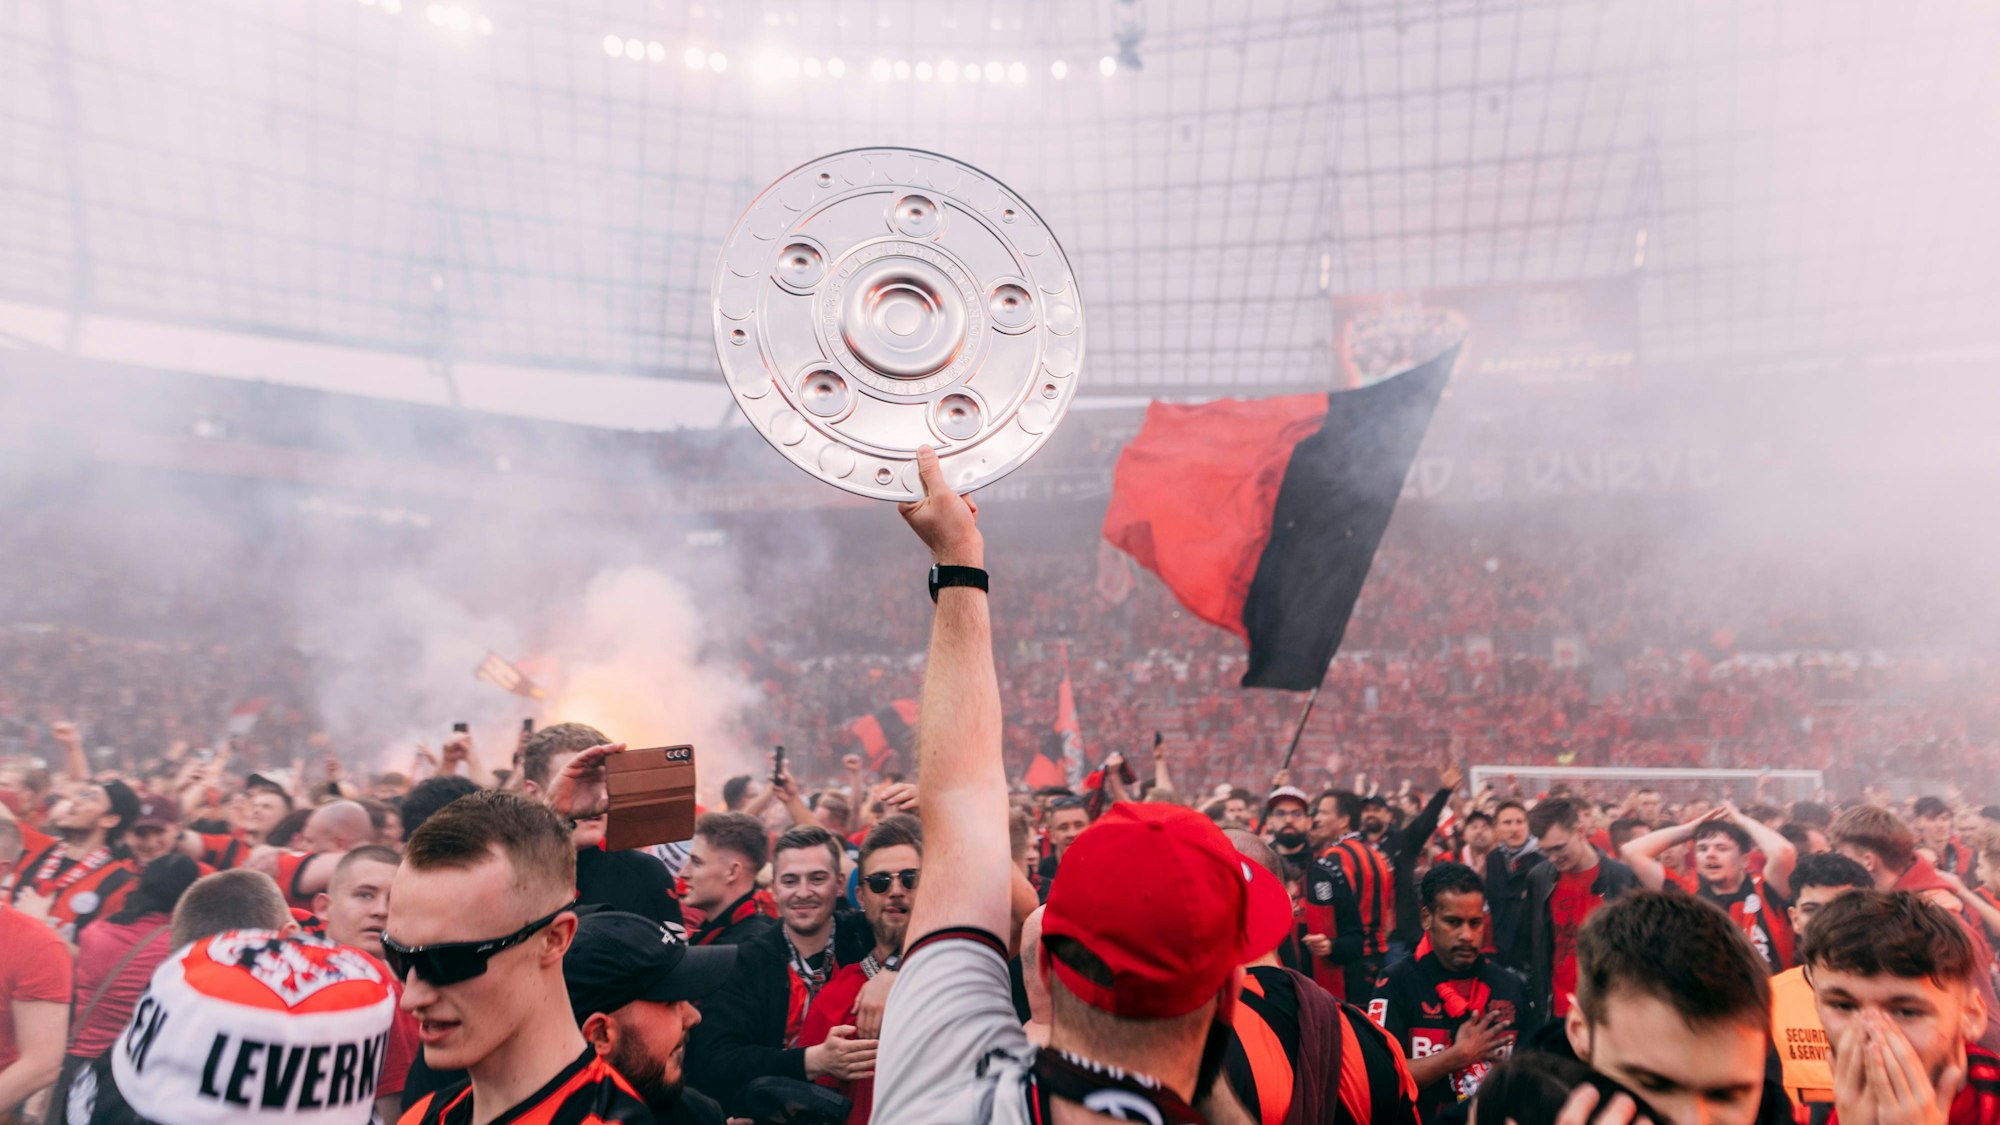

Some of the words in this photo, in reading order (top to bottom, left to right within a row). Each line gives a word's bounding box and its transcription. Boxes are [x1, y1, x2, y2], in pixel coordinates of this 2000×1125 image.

[1785, 1028, 1829, 1043] SECURIT
[1789, 1045, 1797, 1060] &
[200, 1030, 388, 1112] LEVERK
